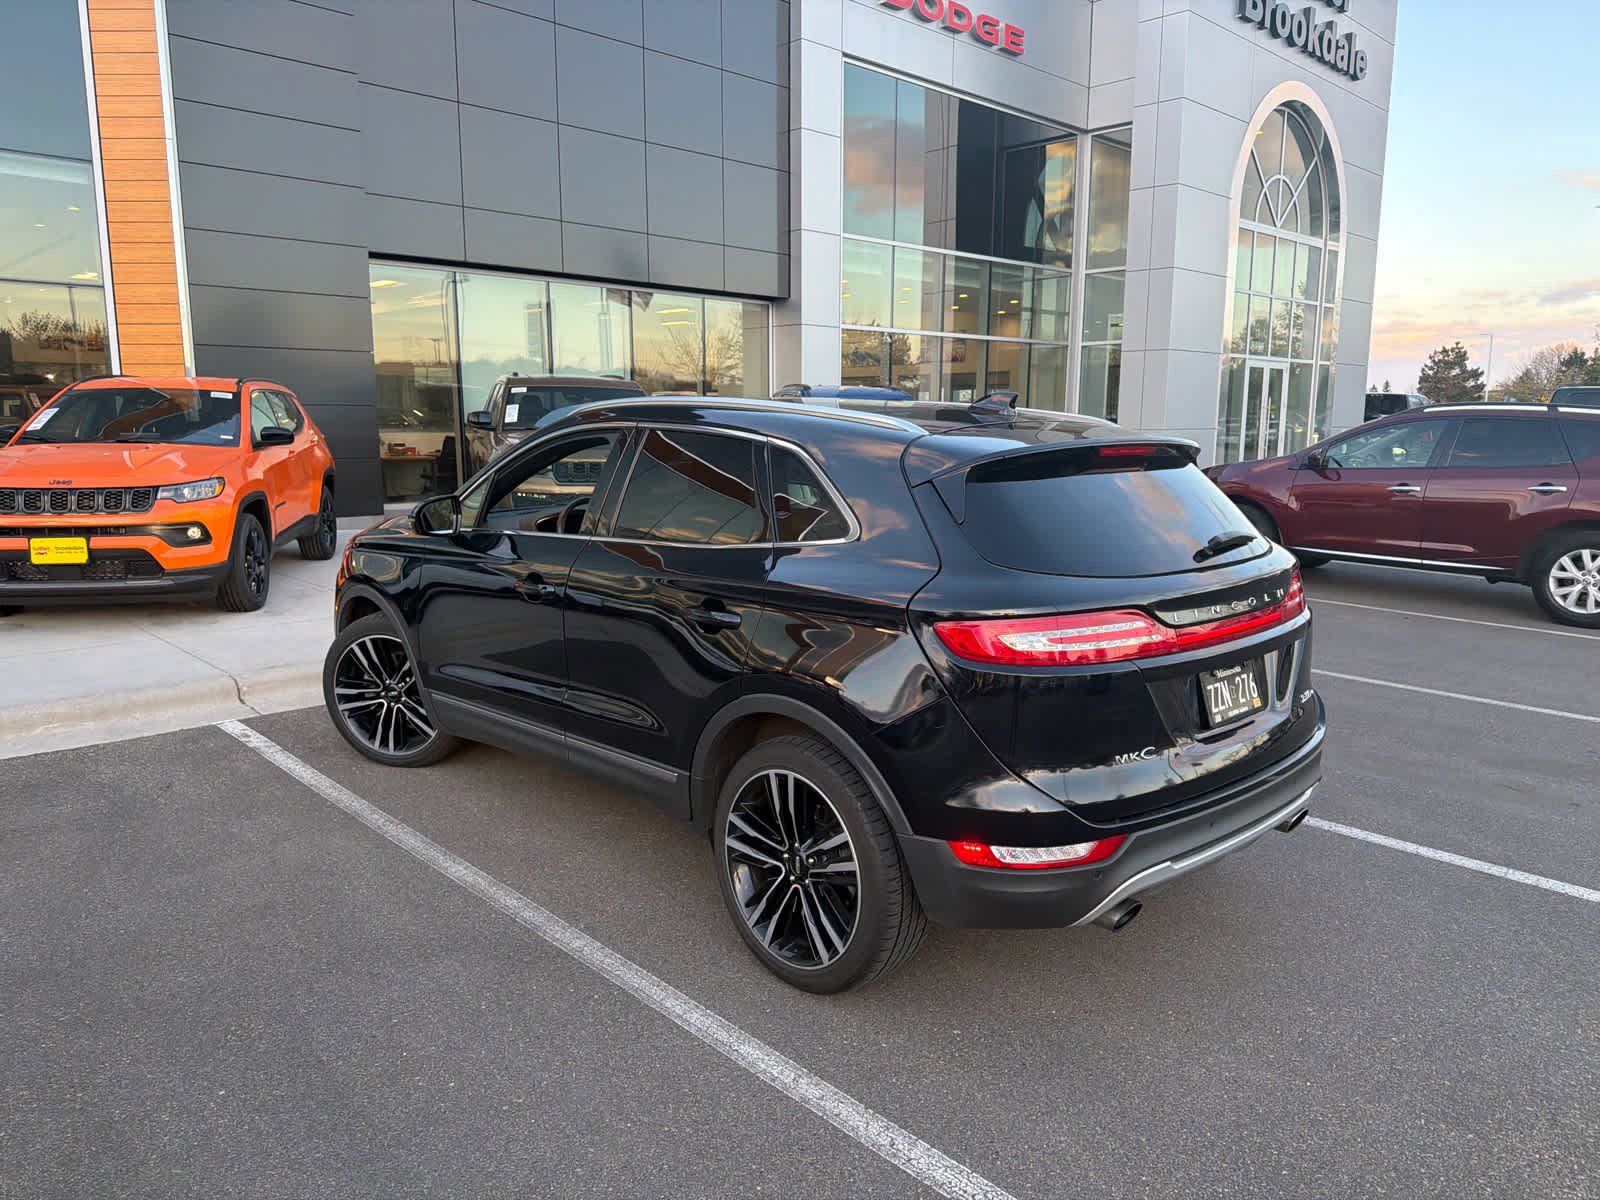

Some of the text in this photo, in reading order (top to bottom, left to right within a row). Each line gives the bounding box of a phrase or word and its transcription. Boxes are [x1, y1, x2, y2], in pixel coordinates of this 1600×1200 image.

[1173, 588, 1285, 622] LINCOLN
[1206, 671, 1258, 713] ZZN 276
[1114, 746, 1157, 765] MKC
